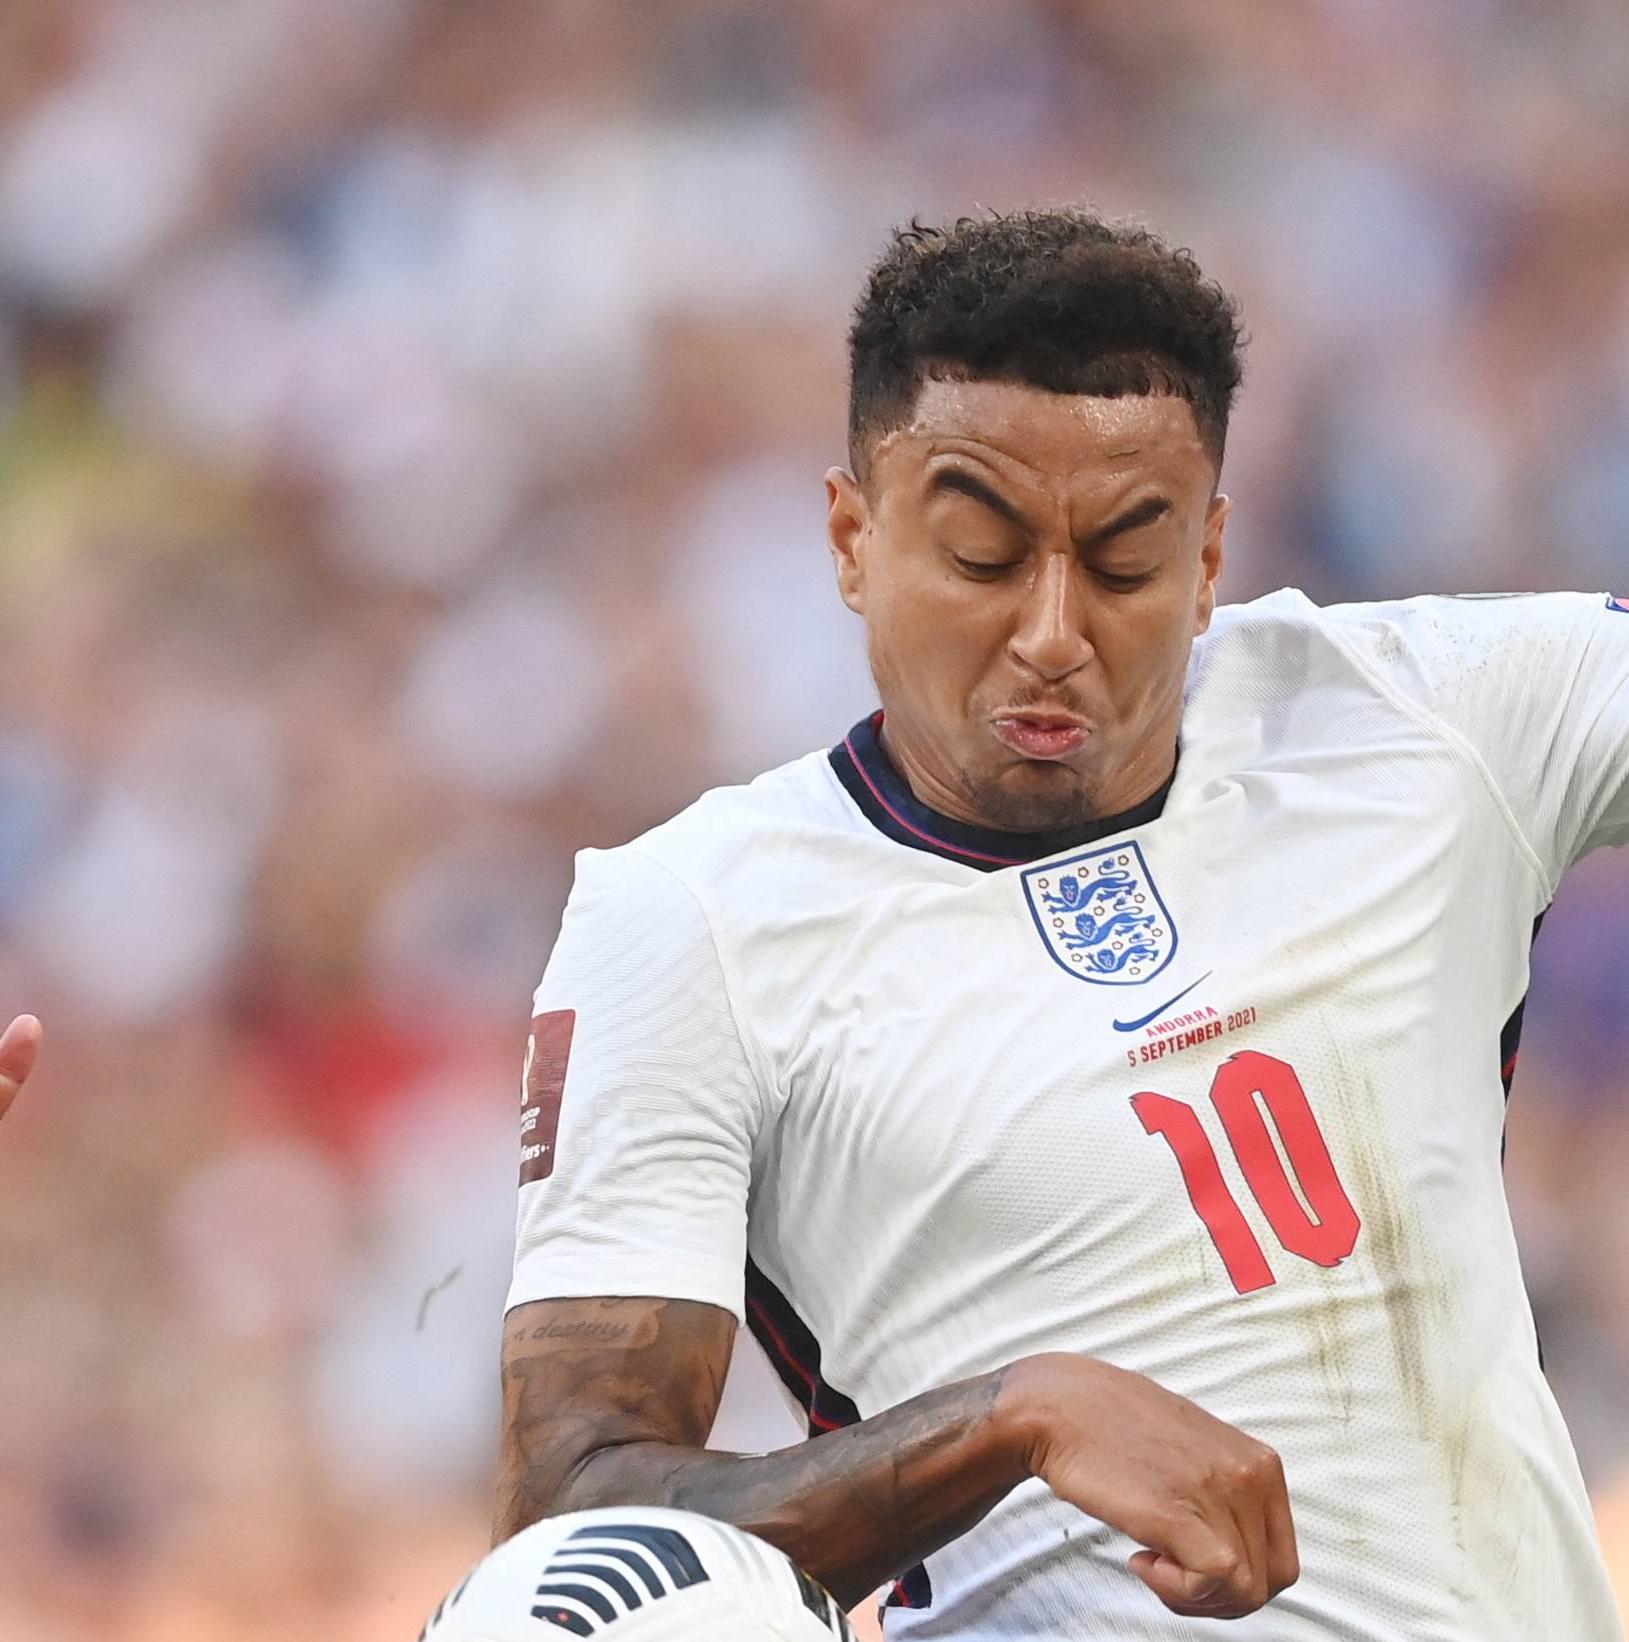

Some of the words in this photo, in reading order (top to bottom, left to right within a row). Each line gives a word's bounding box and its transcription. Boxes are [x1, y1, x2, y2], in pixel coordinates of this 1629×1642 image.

[1140, 1020, 1223, 1062] SEPTEMBER
[1227, 1006, 1257, 1031] 2021
[1145, 1005, 1218, 1038] ANDORRA
[1128, 1049, 1362, 1296] 10
